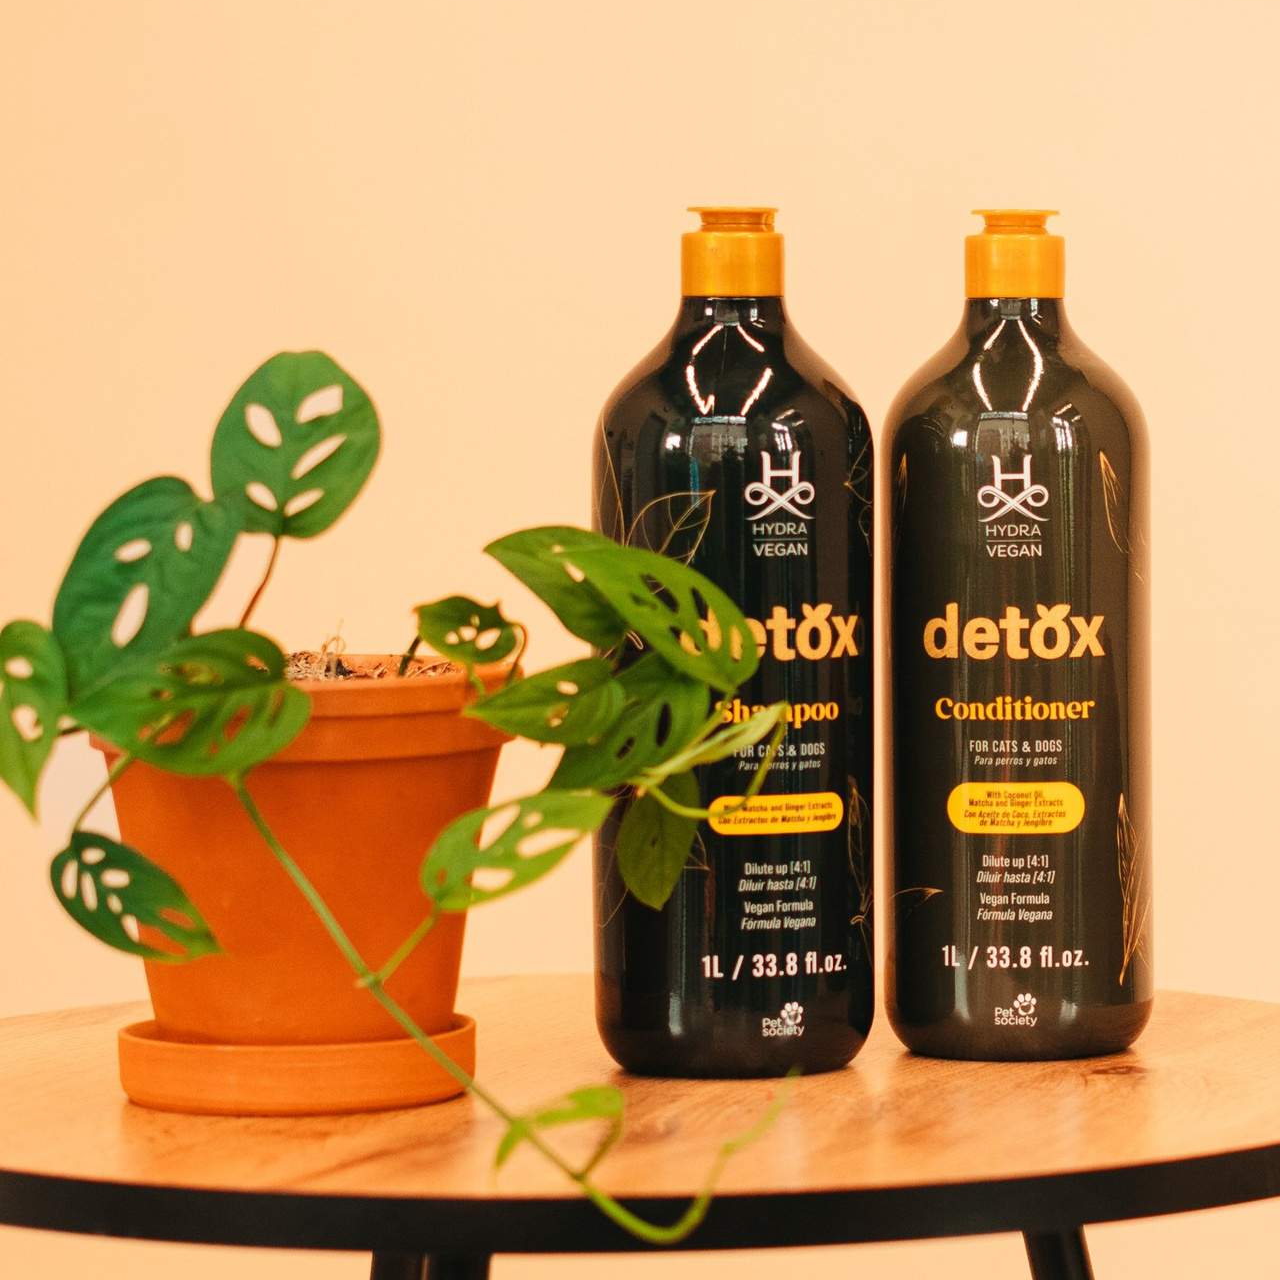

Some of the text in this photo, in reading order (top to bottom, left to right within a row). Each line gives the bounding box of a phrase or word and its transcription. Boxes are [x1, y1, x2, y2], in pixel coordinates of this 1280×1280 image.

[752, 522, 808, 536] HYDRA
[985, 524, 1042, 537] HYDRA
[752, 543, 809, 557] VEGAN
[986, 544, 1043, 558] VEGAN
[923, 602, 1106, 660] detox
[935, 695, 1096, 721] Conditioner
[789, 744, 797, 757] &
[801, 742, 826, 756] DOGS
[969, 739, 1063, 753] FOR CATS & DOGS
[739, 760, 759, 771] Para
[792, 761, 798, 772] y
[799, 759, 822, 771] gatos
[974, 755, 1057, 767] Para perros y gatos
[968, 798, 993, 807] Matcha
[995, 798, 1008, 807] and
[744, 860, 811, 876] Dilute up [4:1]
[982, 854, 1049, 869] Dilute up [4:1]
[738, 876, 817, 892] Diluir hasta [4:1]
[976, 870, 1055, 884] Diluir hasta [4:1]
[980, 892, 1050, 907] Vegan Formula
[744, 899, 814, 915] Vegan Formula
[977, 908, 1053, 922] Fórmula Vegana
[740, 916, 817, 931] Fórmula Vegana
[942, 945, 1090, 971] 1L / 33.8 fl.oz.
[701, 950, 848, 981] 1L / 33.8 fl.oz.
[994, 1007, 1014, 1017] Pet
[762, 1018, 782, 1028] Pet
[994, 1015, 1038, 1027] society
[762, 1025, 804, 1037] society
